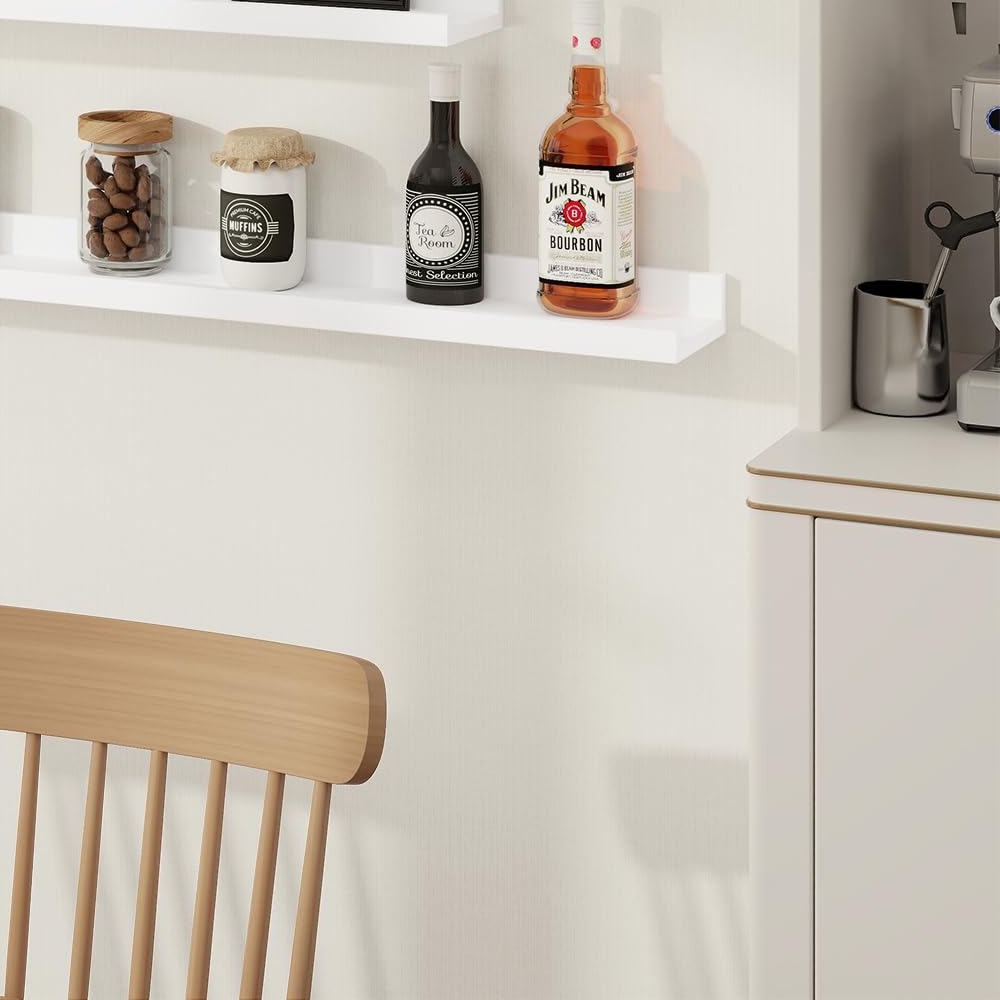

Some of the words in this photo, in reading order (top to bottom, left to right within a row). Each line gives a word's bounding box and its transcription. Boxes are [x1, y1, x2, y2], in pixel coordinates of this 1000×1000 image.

[571, 209, 578, 218] B
[229, 220, 264, 233] MUFFINS
[414, 221, 436, 236] Tea
[418, 235, 456, 250] Room
[550, 235, 602, 252] BOURBON
[425, 270, 478, 280] Selection
